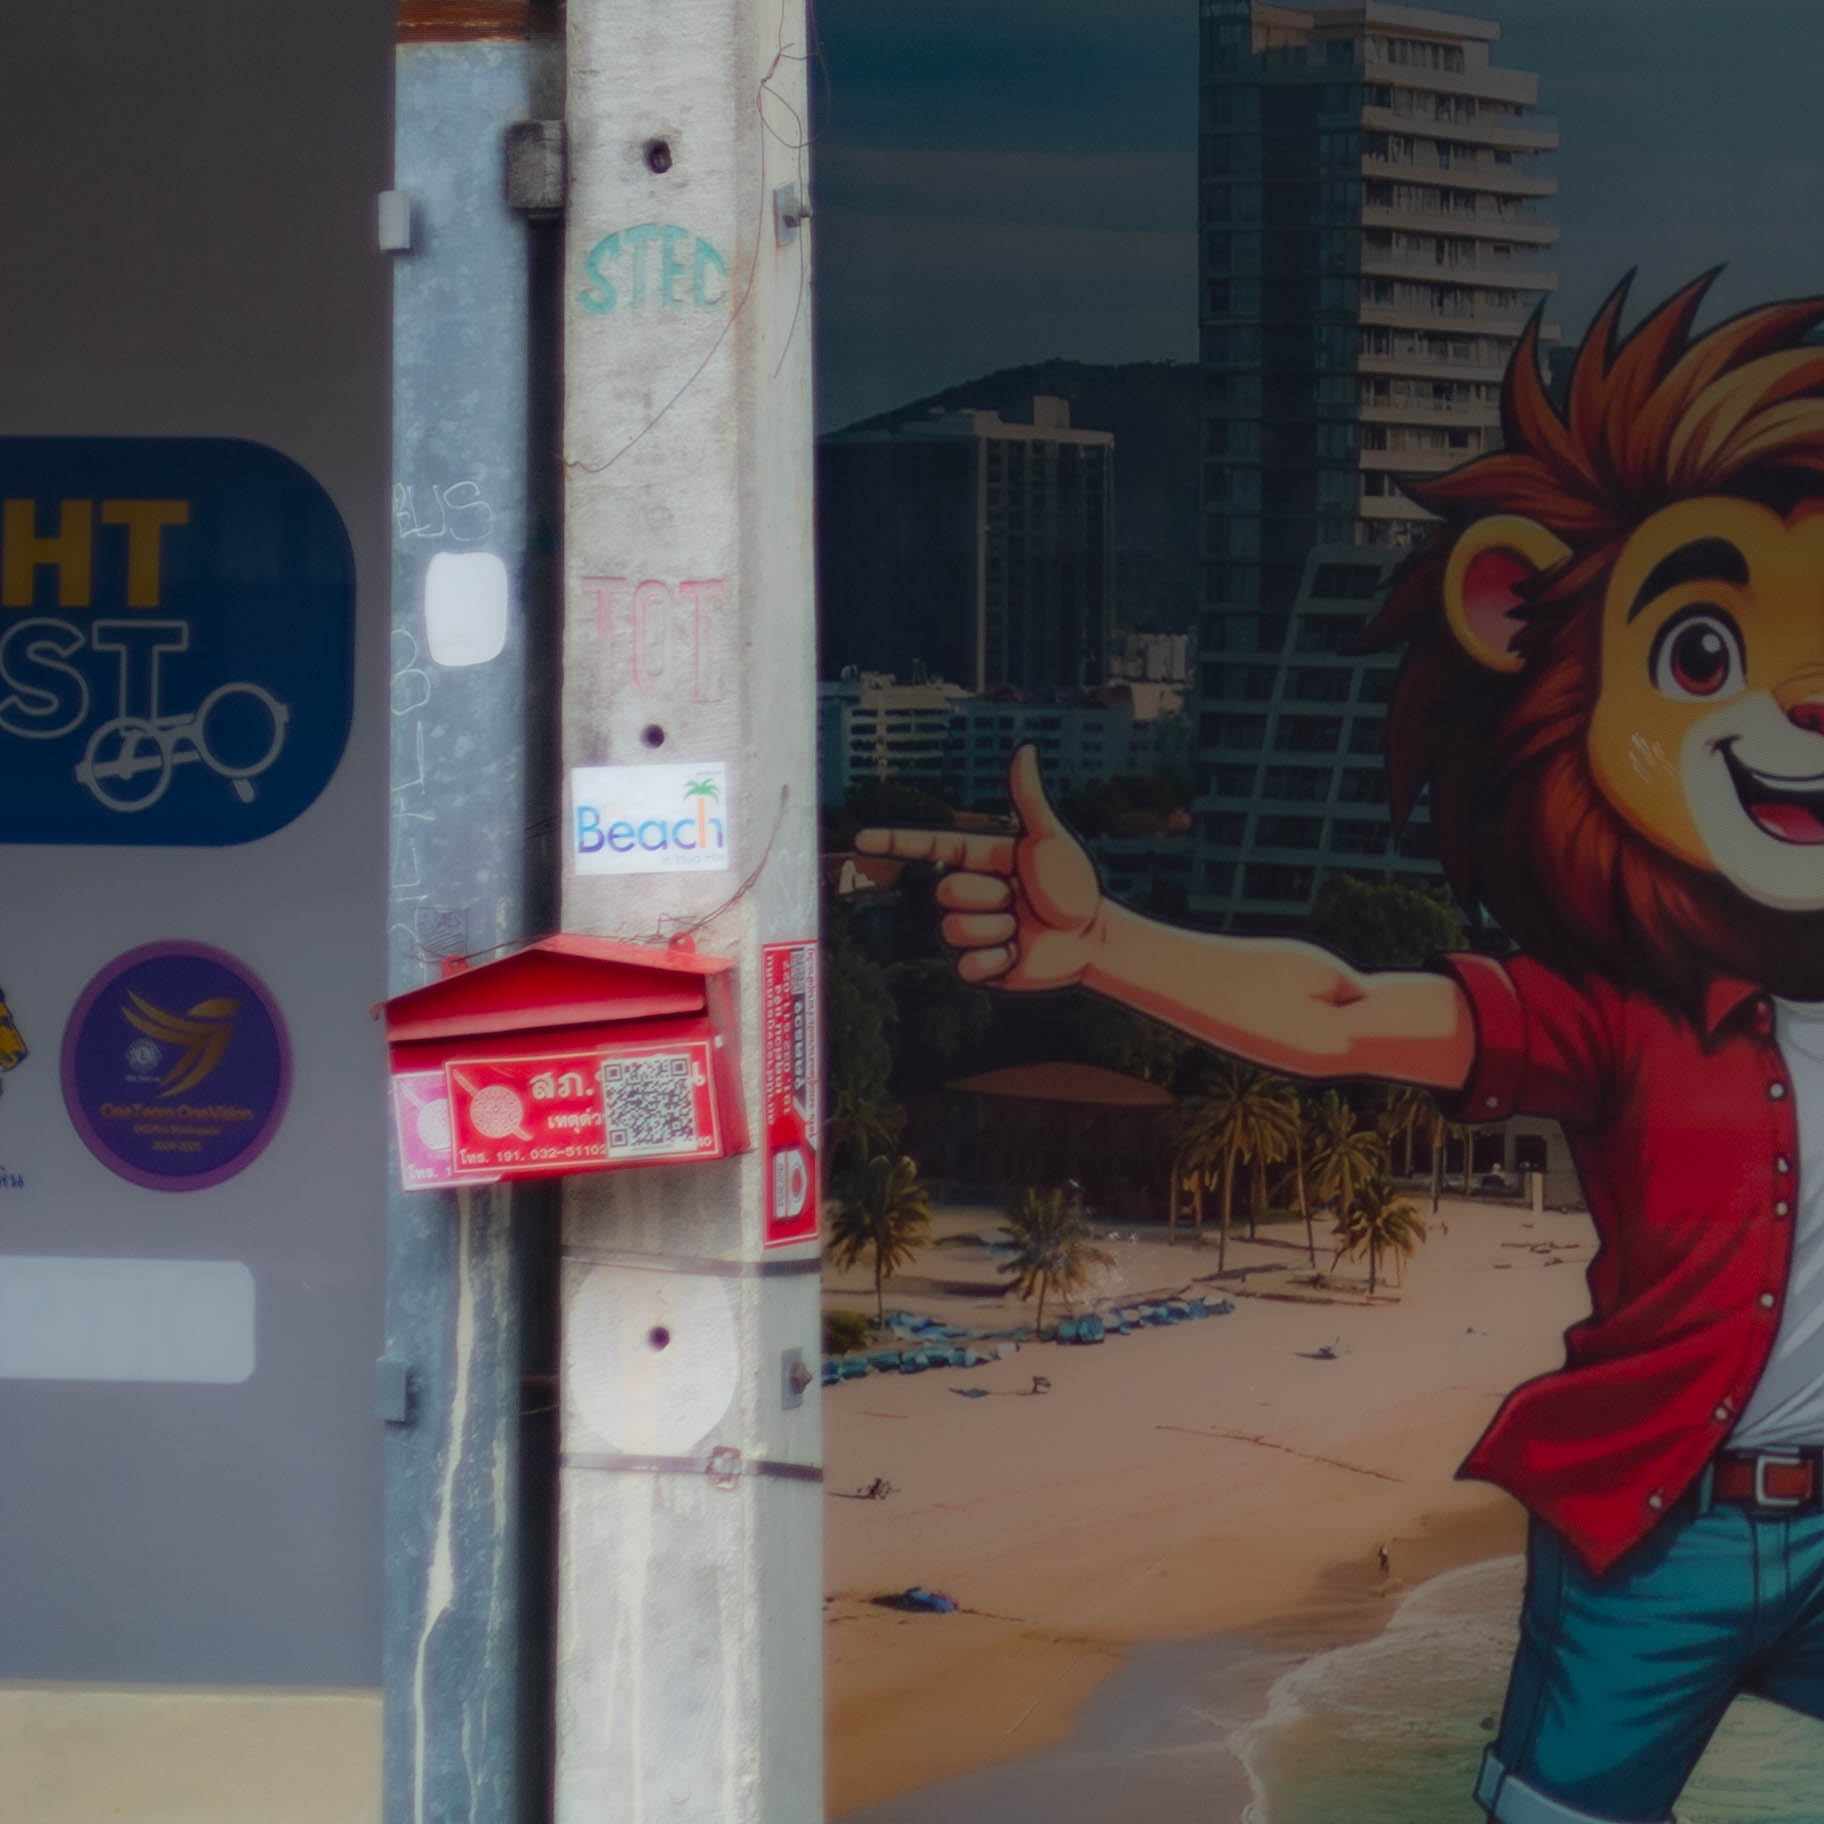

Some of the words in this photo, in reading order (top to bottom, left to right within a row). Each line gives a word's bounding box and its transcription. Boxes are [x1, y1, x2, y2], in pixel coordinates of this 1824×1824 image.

[576, 788, 725, 854] Beach
[546, 1106, 605, 1134] เหตุด่ว
